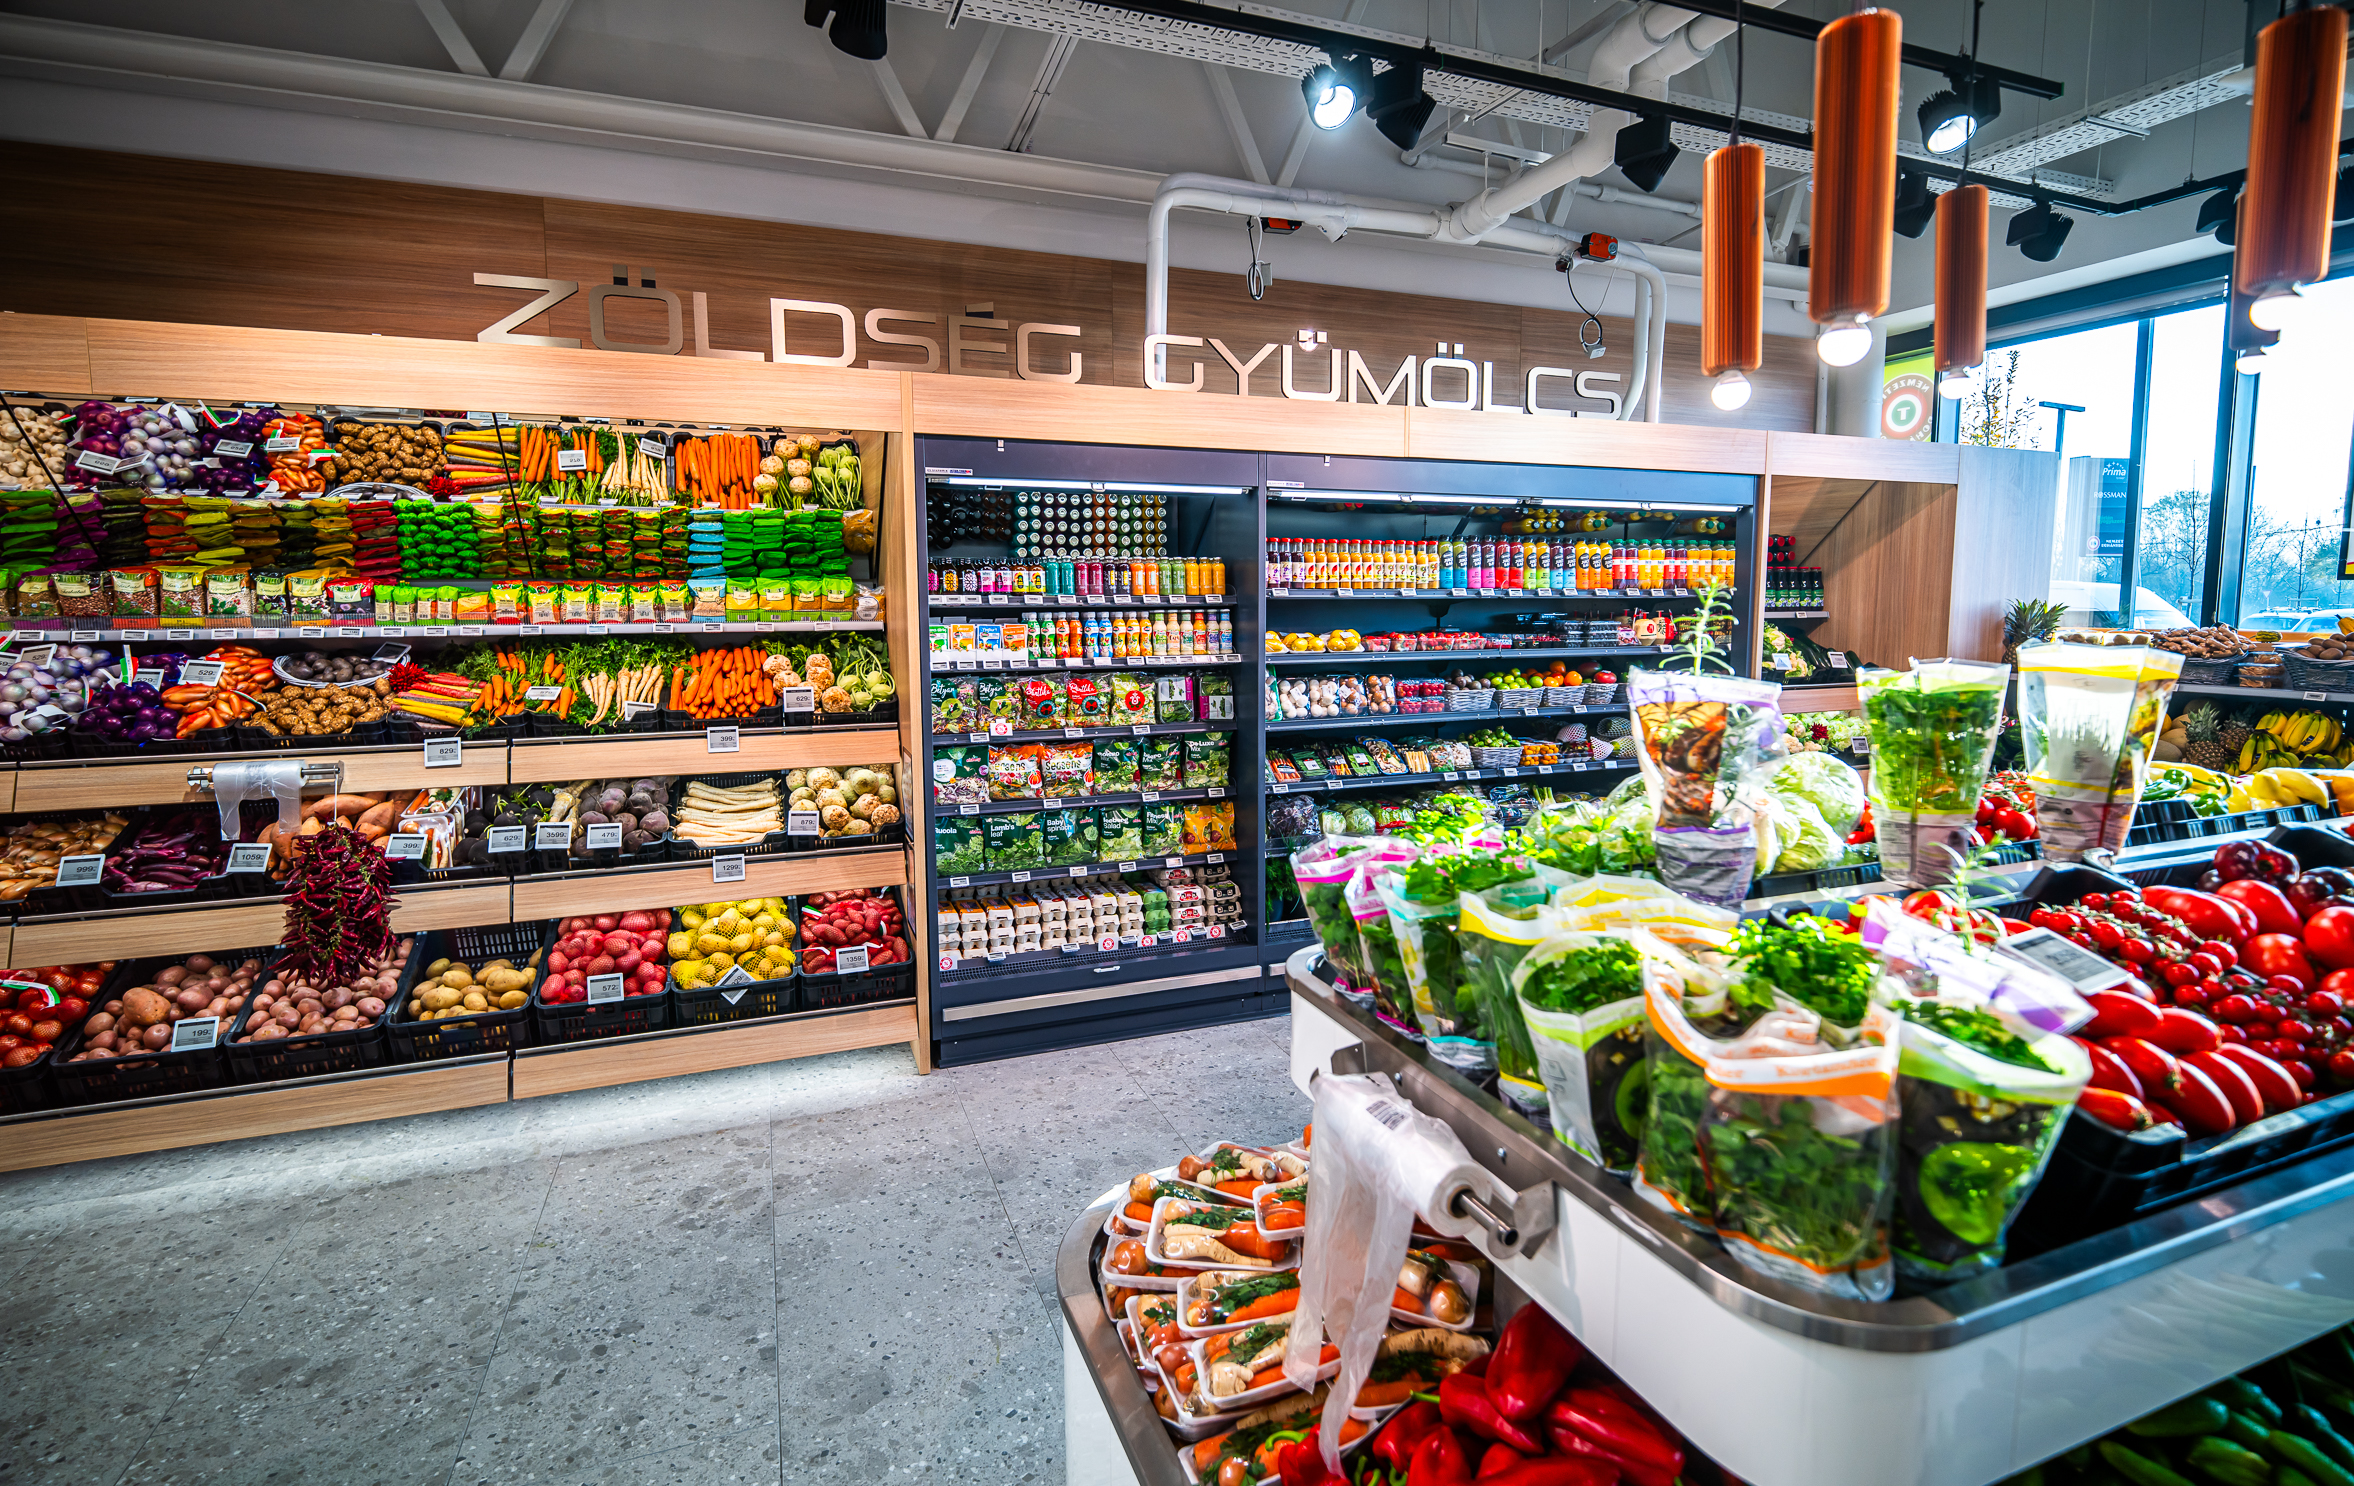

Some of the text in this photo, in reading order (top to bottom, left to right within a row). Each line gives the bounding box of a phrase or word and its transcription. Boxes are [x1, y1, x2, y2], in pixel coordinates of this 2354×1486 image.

[473, 263, 1622, 421] ZÖLDSÉG GYÜMÖLCS
[2094, 491, 2126, 499] ROSSMAN
[990, 823, 1014, 831] Lamb's
